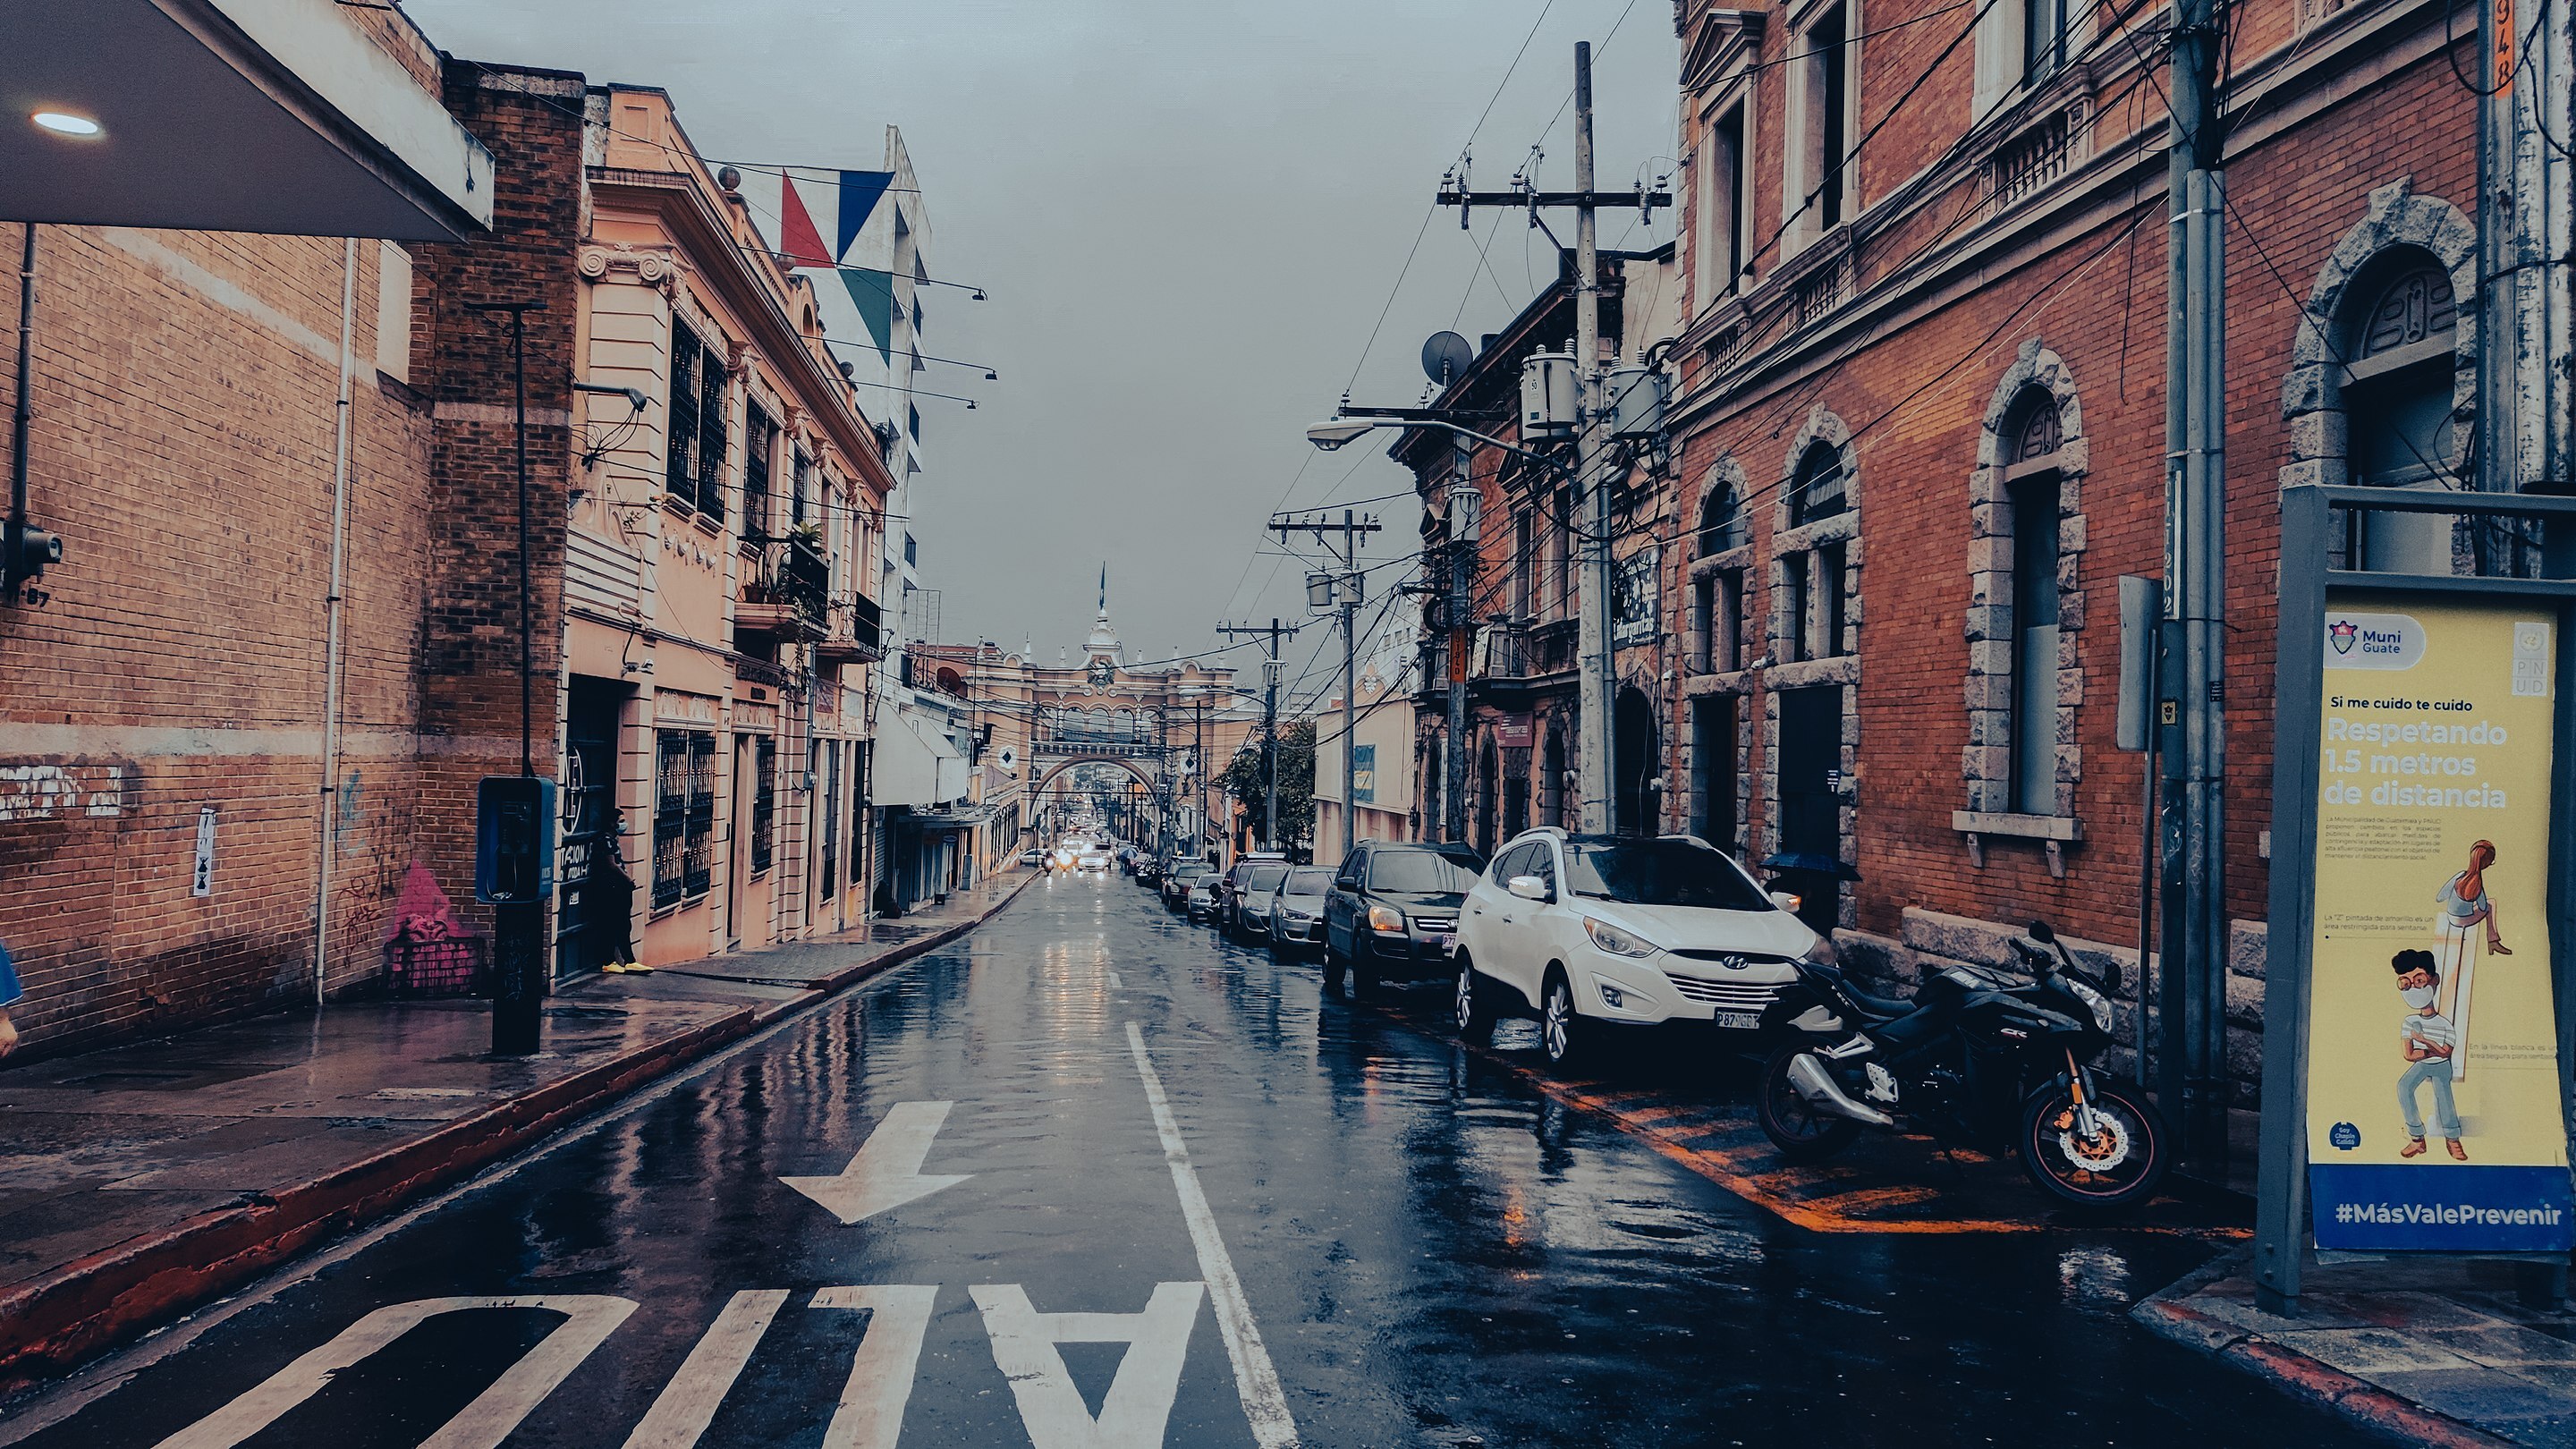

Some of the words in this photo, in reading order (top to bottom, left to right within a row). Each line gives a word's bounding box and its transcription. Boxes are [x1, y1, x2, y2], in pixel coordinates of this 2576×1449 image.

[2362, 643, 2401, 654] Guate
[2363, 631, 2402, 644] Muni
[2330, 696, 2343, 708] Si
[2348, 698, 2369, 708] me
[2373, 697, 2412, 710] cuido
[2417, 699, 2430, 710] te
[2434, 699, 2473, 711] cuido
[2327, 717, 2508, 747] Respetando
[2326, 750, 2361, 773] 1.5
[2370, 752, 2476, 776] metros
[2324, 780, 2362, 804] de
[2370, 780, 2506, 809] distancia
[2335, 1202, 2562, 1225] #MásValePrevenir
